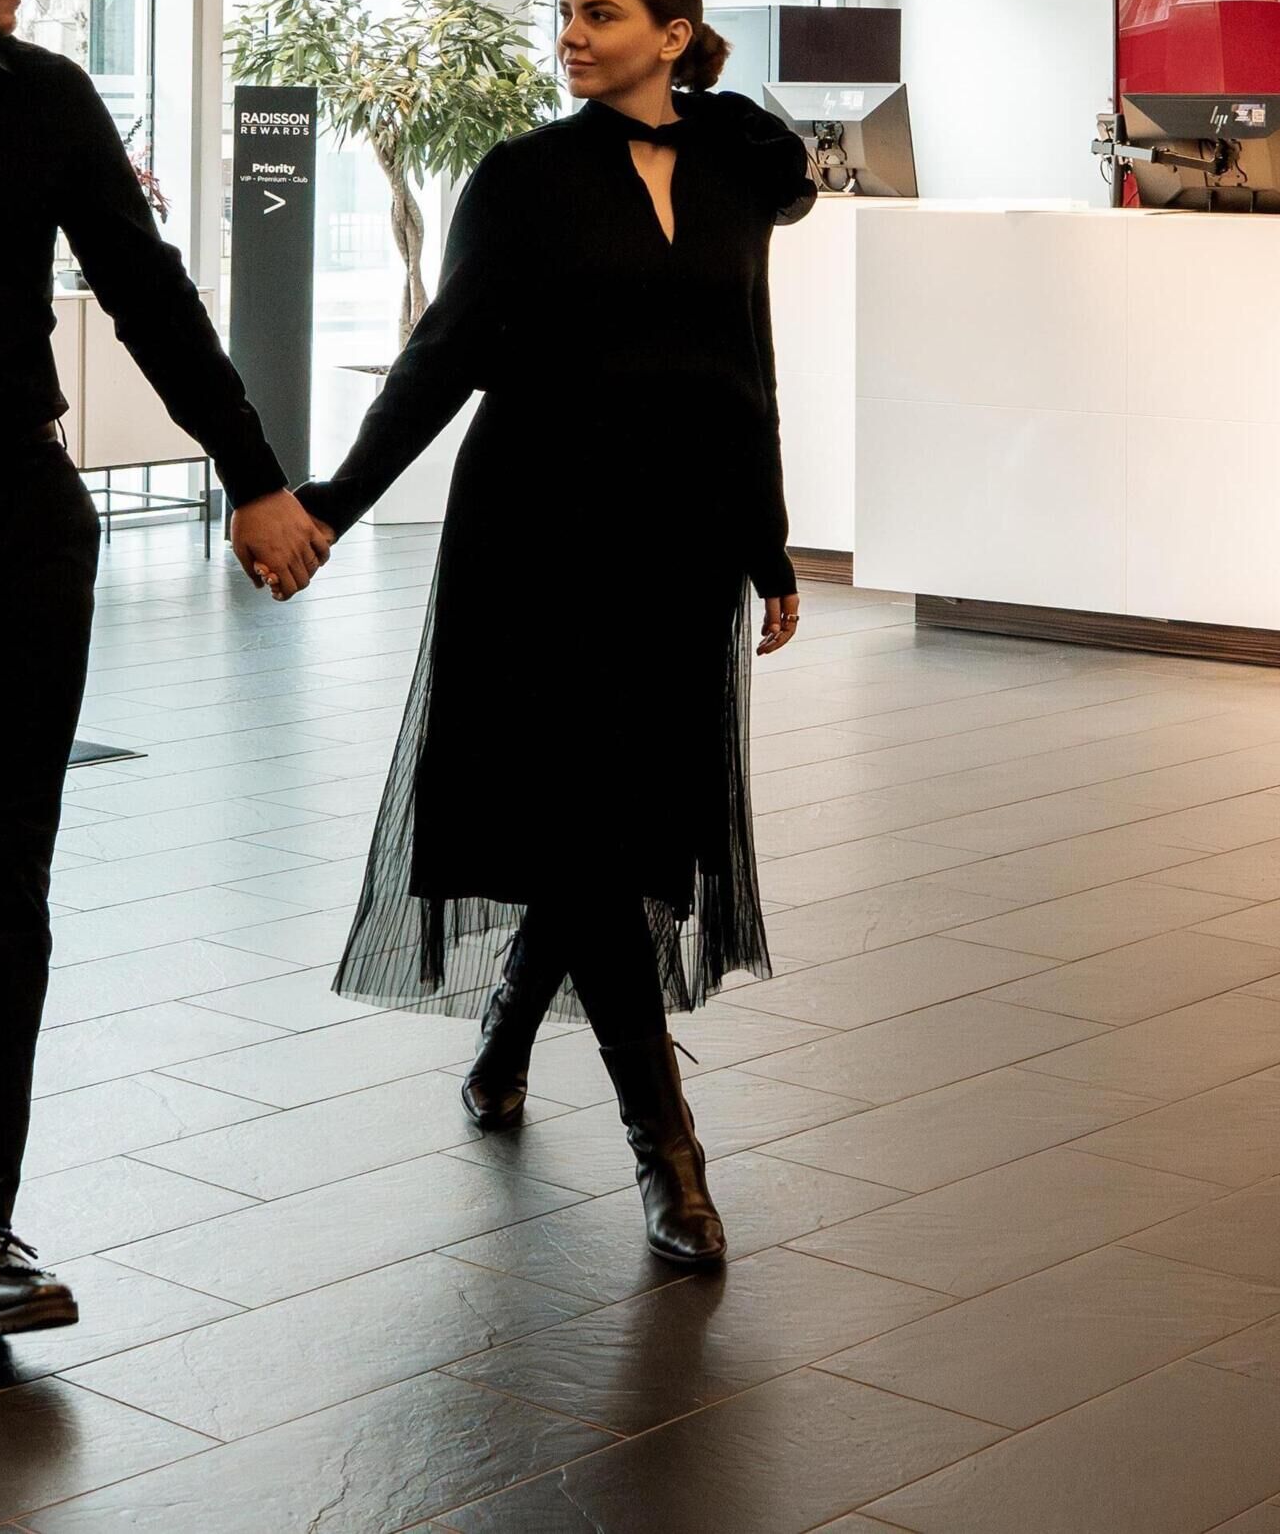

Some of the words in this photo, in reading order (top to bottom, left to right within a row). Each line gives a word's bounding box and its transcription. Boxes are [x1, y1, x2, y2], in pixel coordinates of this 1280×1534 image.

[240, 112, 310, 125] RADISSON
[240, 126, 310, 135] REWARDS
[252, 163, 296, 174] Priority
[257, 175, 287, 183] Premium
[292, 175, 309, 183] Club
